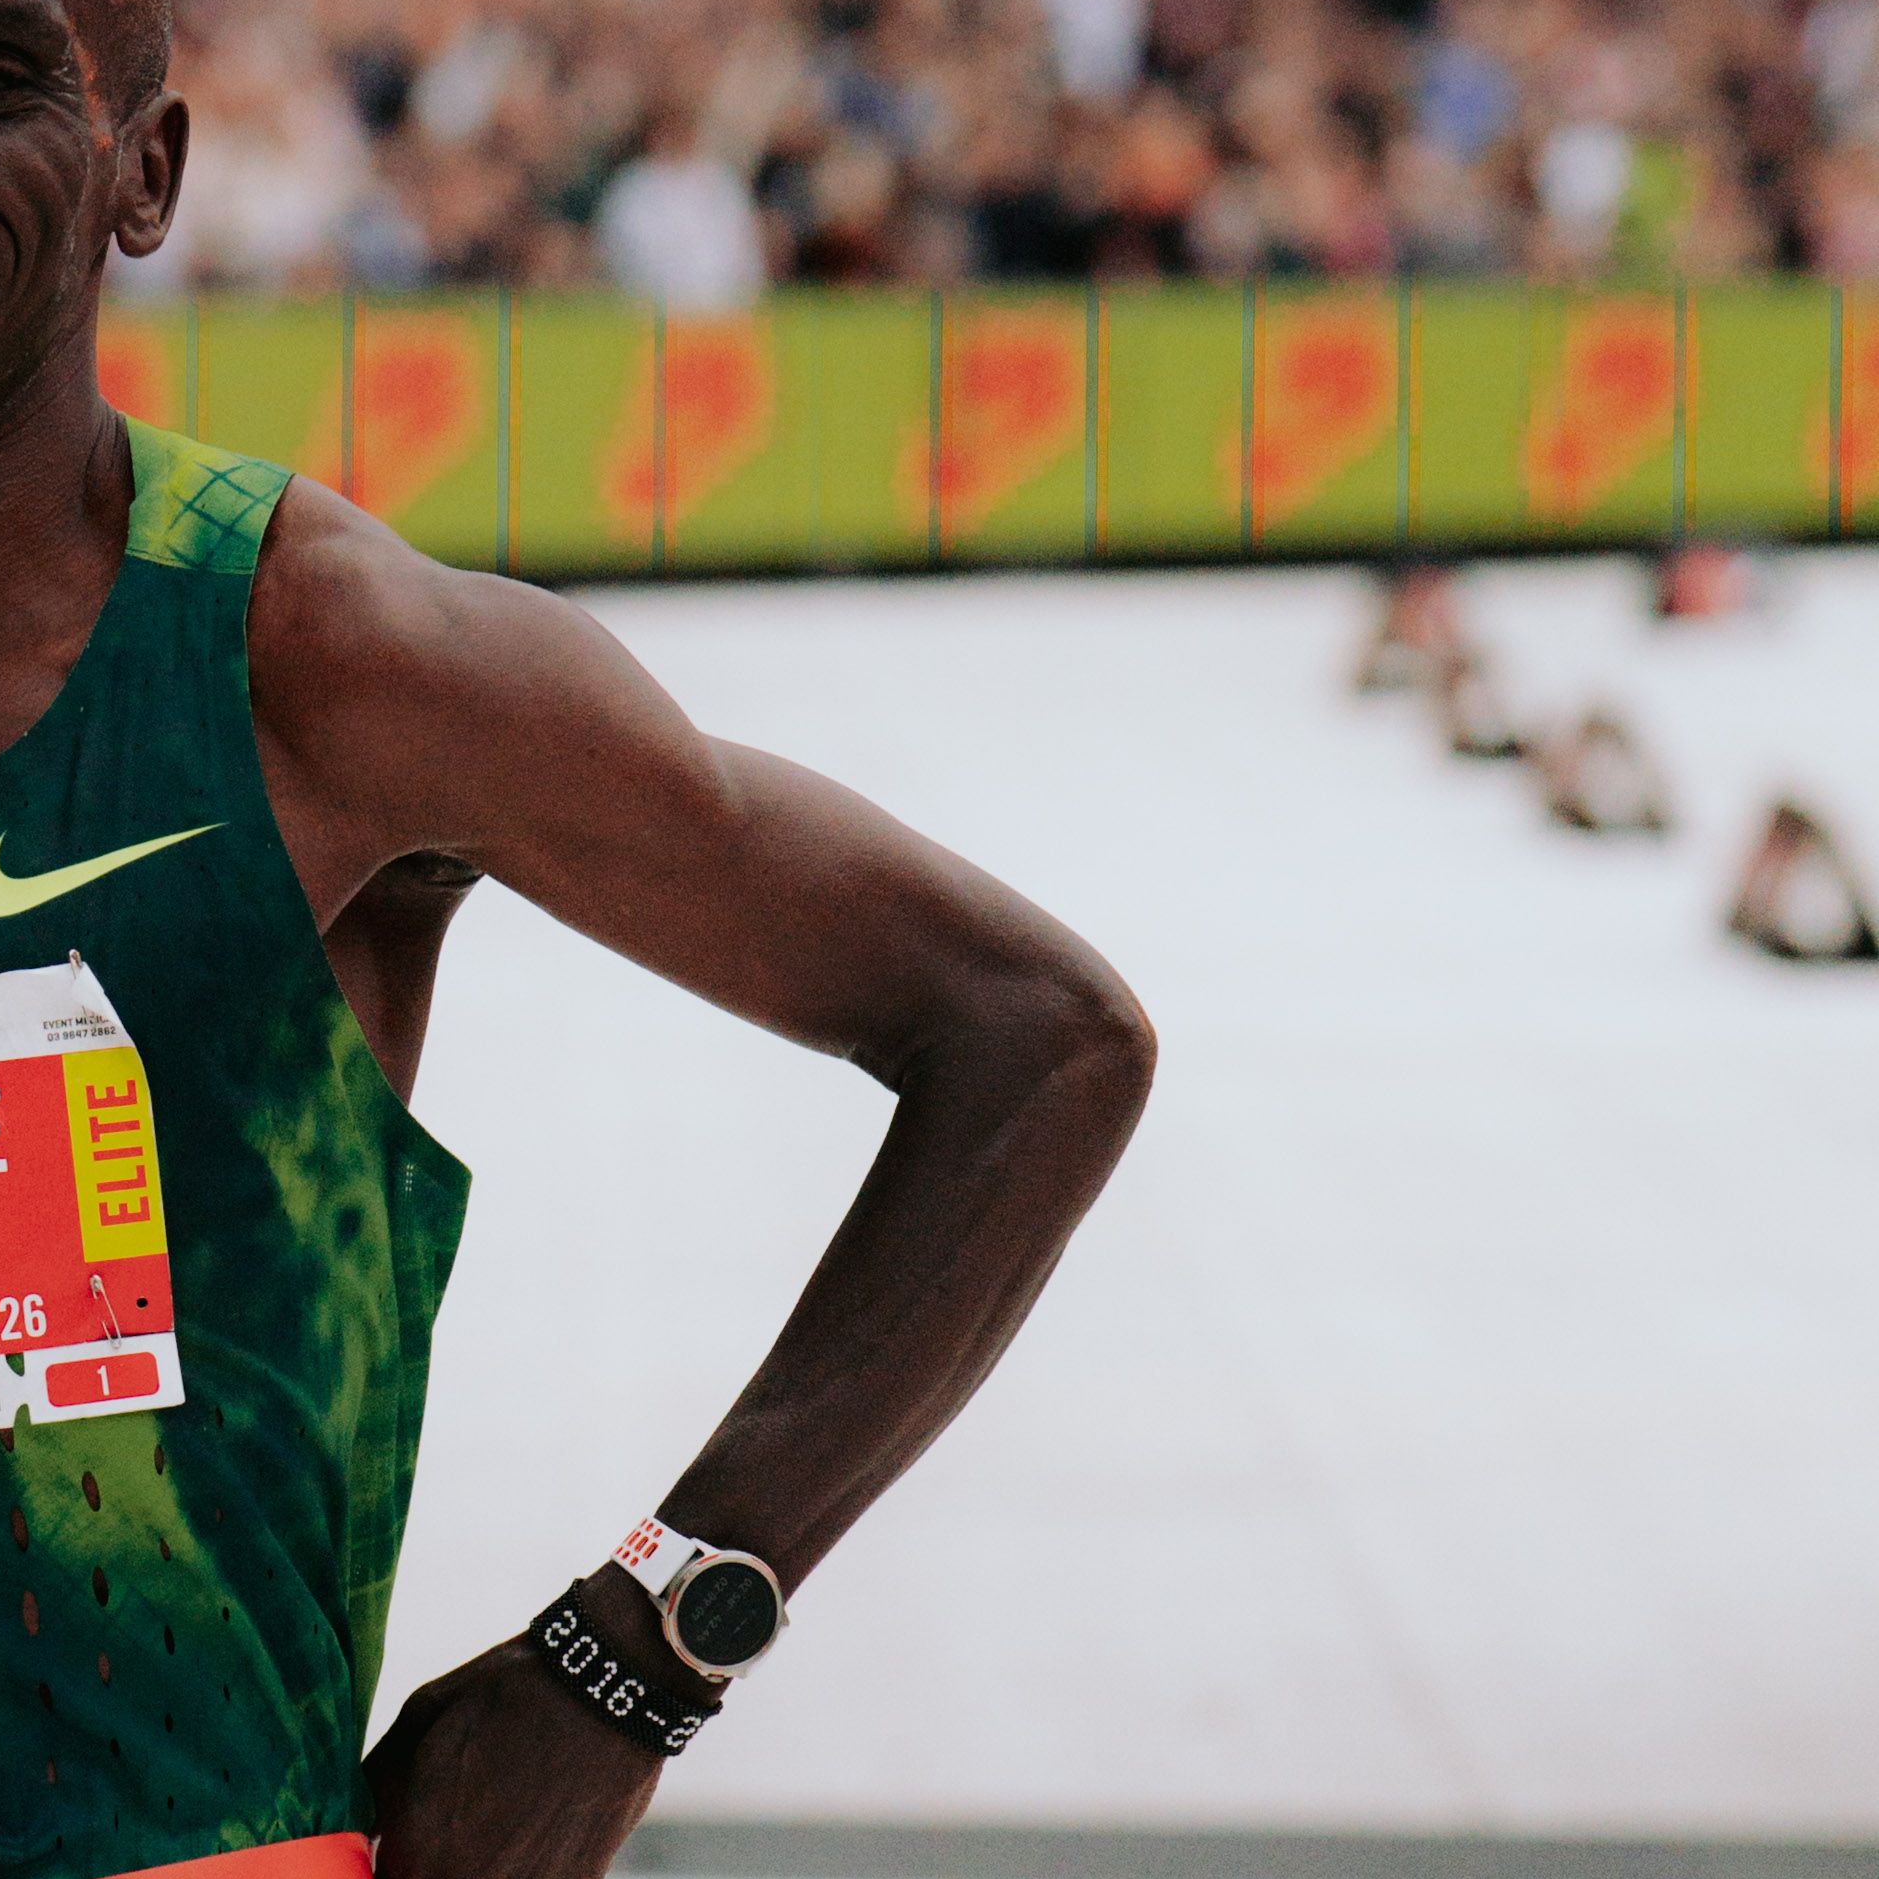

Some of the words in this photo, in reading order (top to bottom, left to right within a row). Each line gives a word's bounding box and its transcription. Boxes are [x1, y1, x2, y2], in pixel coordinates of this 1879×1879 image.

[43, 1017, 72, 1029] EVENT
[47, 1033, 60, 1042] 03
[86, 1079, 152, 1227] ELITE
[96, 1365, 110, 1396] 1
